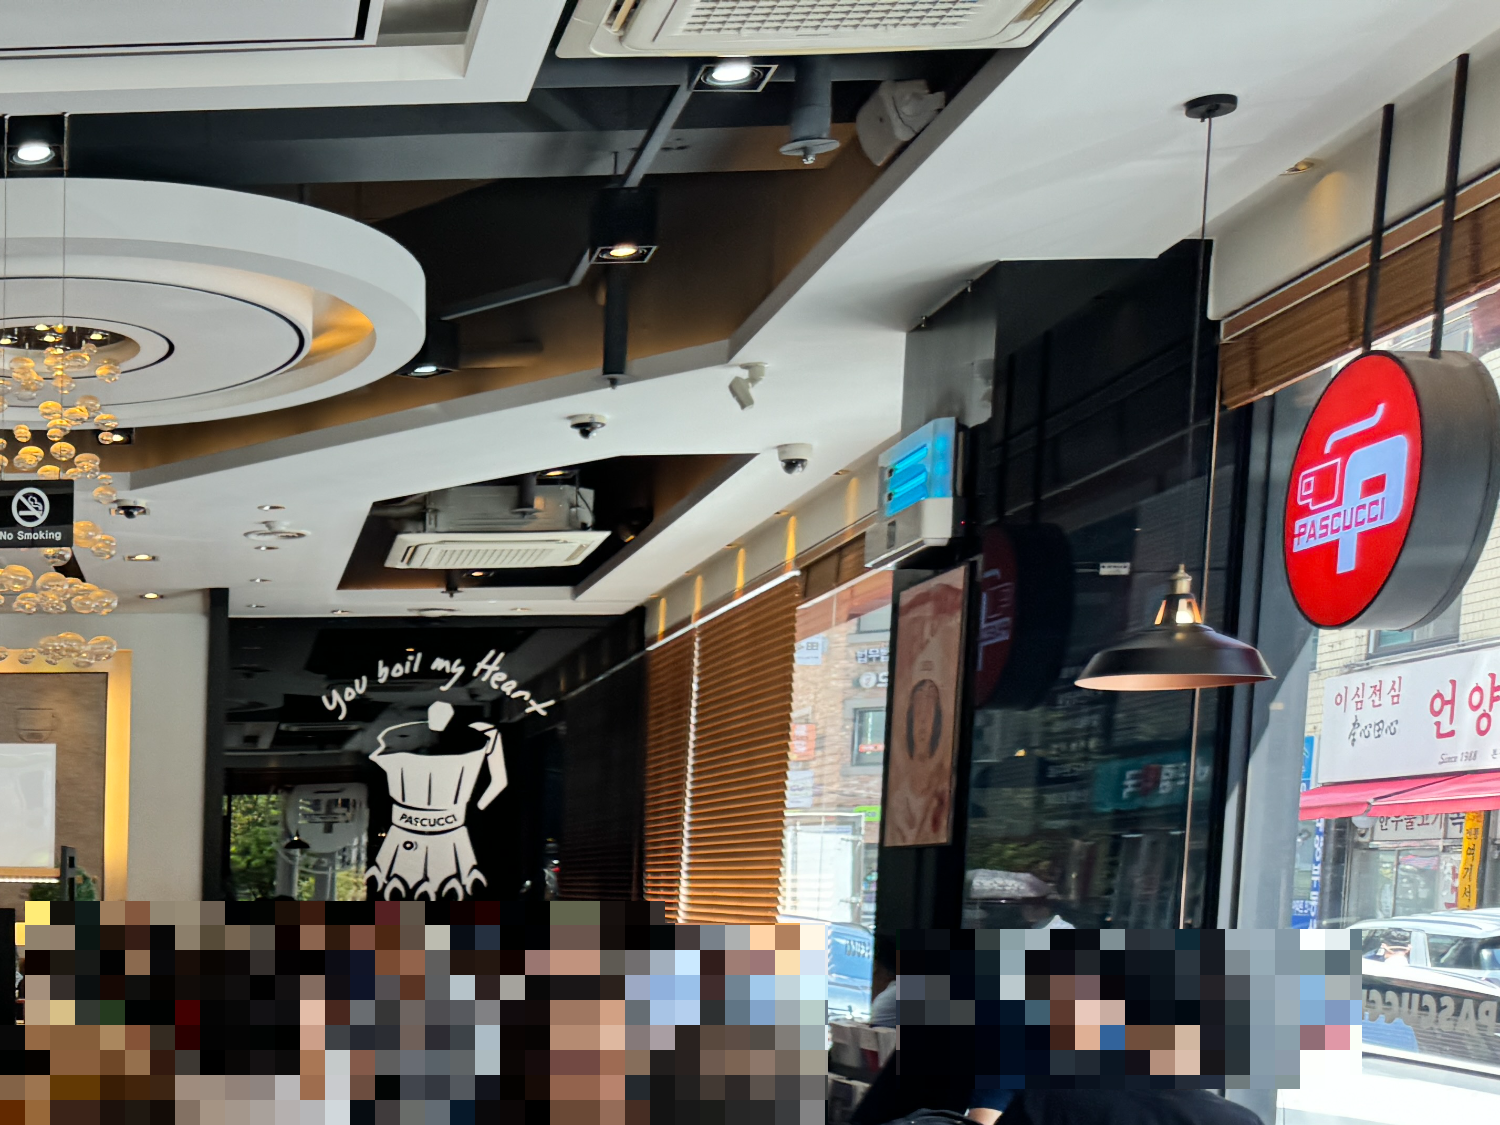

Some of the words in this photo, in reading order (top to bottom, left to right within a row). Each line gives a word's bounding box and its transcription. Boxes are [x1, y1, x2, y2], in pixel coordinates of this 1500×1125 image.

[0, 531, 13, 540] No
[17, 530, 62, 541] Smoking
[1294, 497, 1385, 546] PASCUCCI
[322, 675, 367, 720] You
[377, 652, 422, 683] boil
[431, 657, 465, 691] my
[472, 649, 556, 716] Heart
[1334, 676, 1403, 713] 이심전심
[400, 813, 458, 827] PASCUCCI
